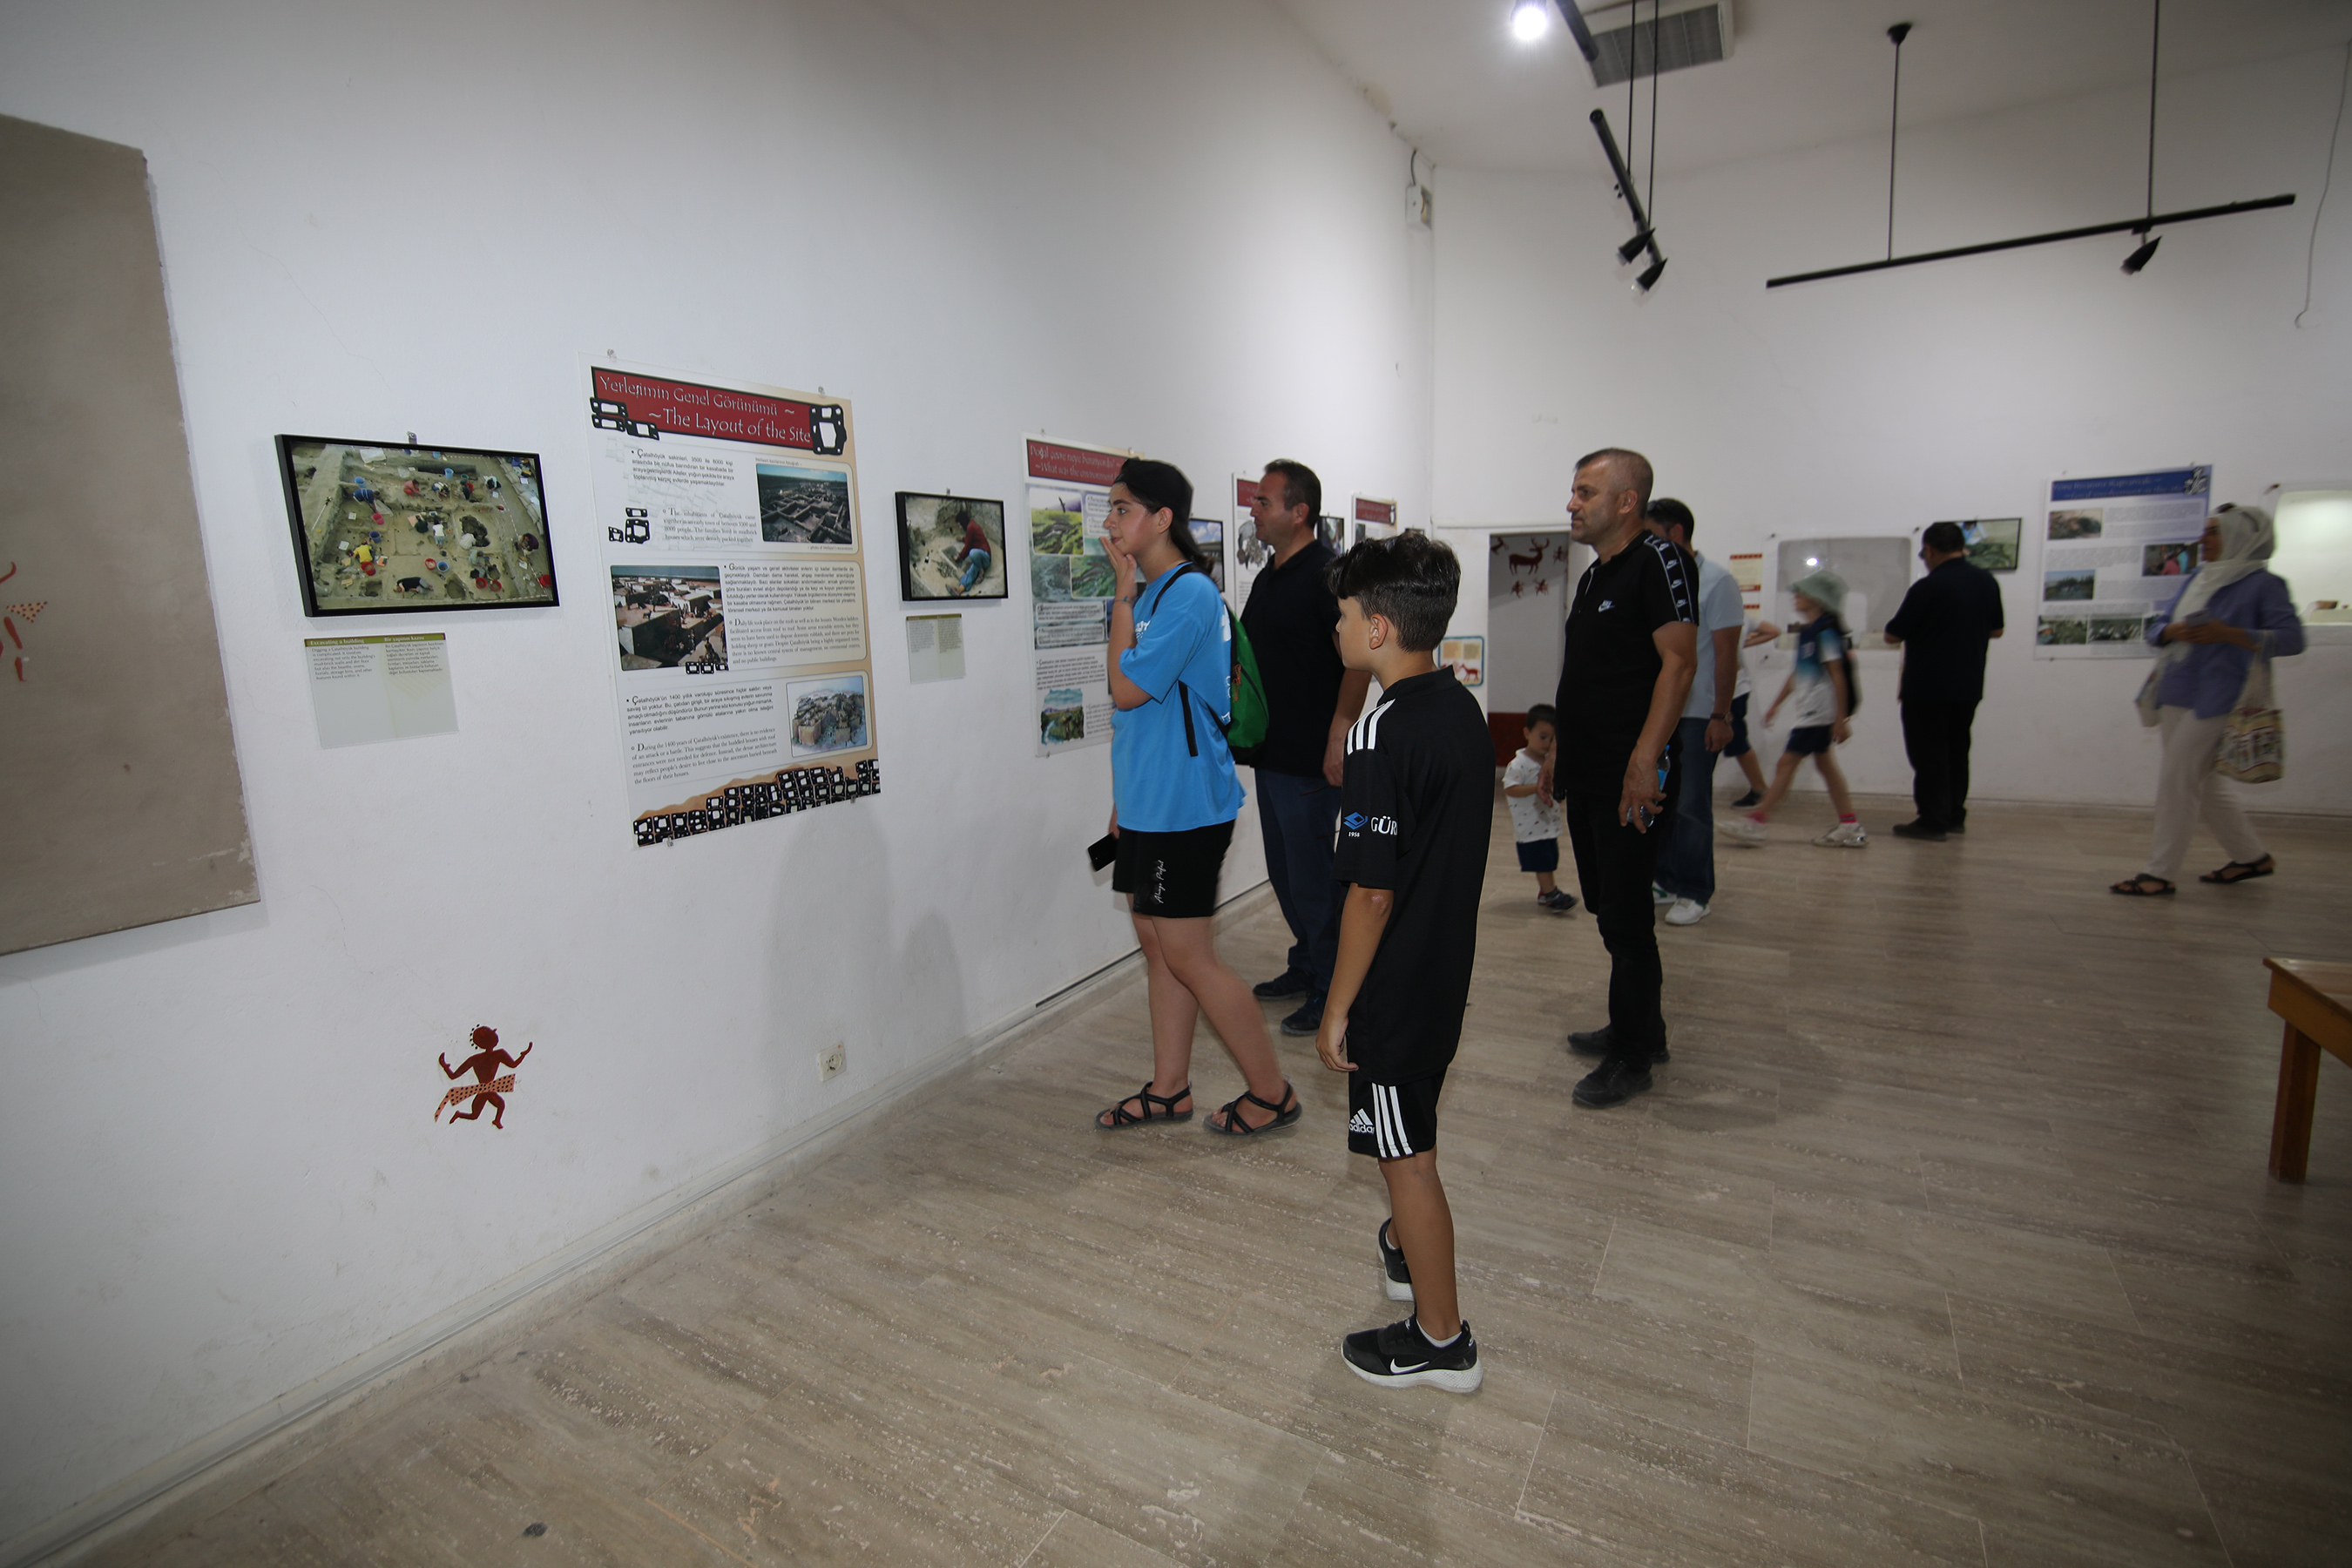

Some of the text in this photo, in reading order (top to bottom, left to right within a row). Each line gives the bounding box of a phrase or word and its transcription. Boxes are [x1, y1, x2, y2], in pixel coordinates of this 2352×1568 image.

[599, 376, 670, 401] Yerleşimin
[673, 388, 710, 406] Genel
[713, 394, 777, 416] Görünümü
[696, 413, 743, 436] Layout
[747, 418, 761, 436] of
[766, 420, 786, 439] the
[789, 426, 811, 443] Site
